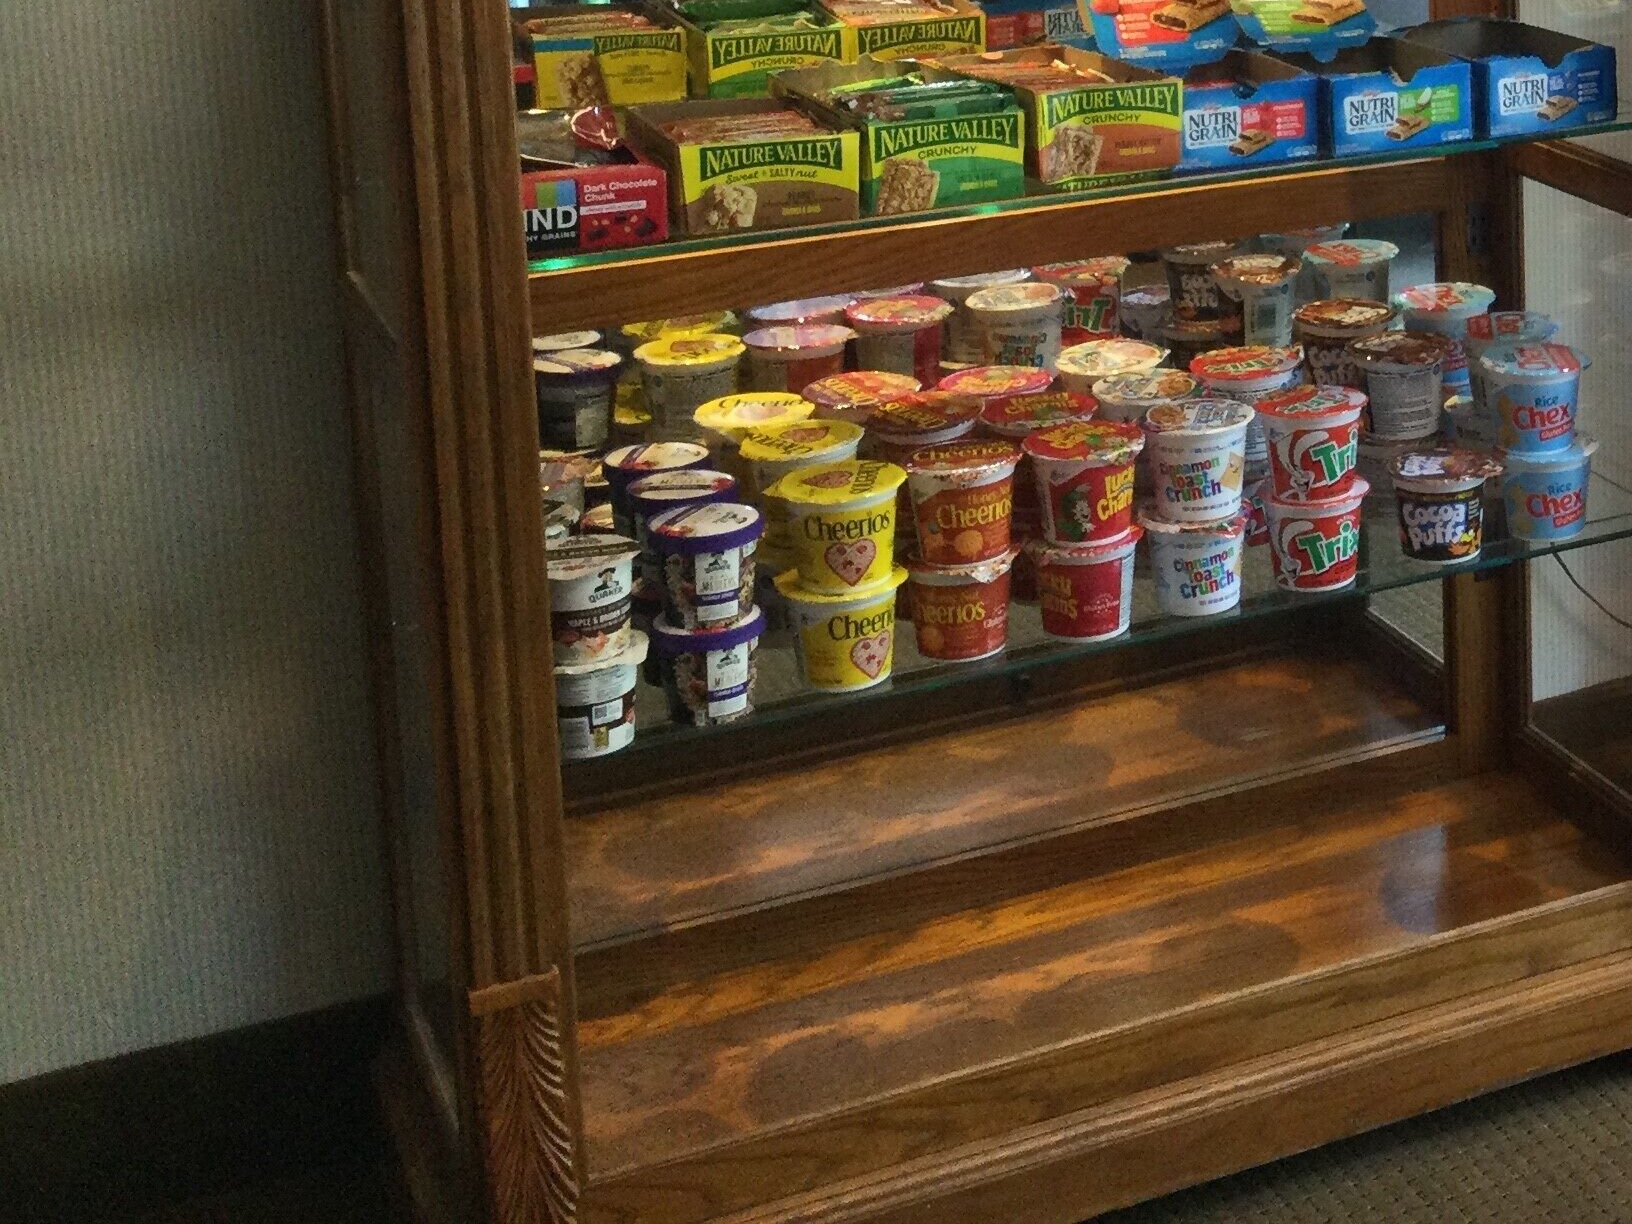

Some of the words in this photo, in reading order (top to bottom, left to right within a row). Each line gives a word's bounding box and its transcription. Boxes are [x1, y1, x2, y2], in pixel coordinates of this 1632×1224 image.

[1502, 78, 1545, 96] NUTRI
[1052, 91, 1114, 125] NATURE
[1115, 86, 1175, 113] VALLEY
[1349, 96, 1396, 115] NUTRI
[1502, 92, 1544, 108] GRAIN
[1083, 113, 1142, 125] CRUNCHY
[1188, 109, 1238, 130] NUTRI
[1349, 109, 1396, 127] GRAIN
[880, 122, 949, 157] NATURE
[950, 117, 1015, 144] VALLEY
[1188, 123, 1238, 142] GRAIN
[706, 145, 775, 177] NATURE
[776, 140, 838, 167] VALLEY
[918, 145, 977, 159] CRUNCHY
[583, 183, 607, 192] Dark
[608, 178, 658, 191] Chocolate
[584, 192, 616, 203] Chunk
[523, 205, 578, 233] IND
[1534, 395, 1559, 409] Rice
[1511, 404, 1571, 430] Chex
[1165, 478, 1222, 504] Crunch
[1546, 482, 1572, 496] Rice
[1525, 487, 1583, 518] Chex
[1403, 502, 1468, 525] Cocoa
[803, 510, 891, 542] Cheerios
[1409, 522, 1467, 550] Puffs
[588, 586, 623, 603] QUAKER
[1180, 569, 1235, 600] Crunch
